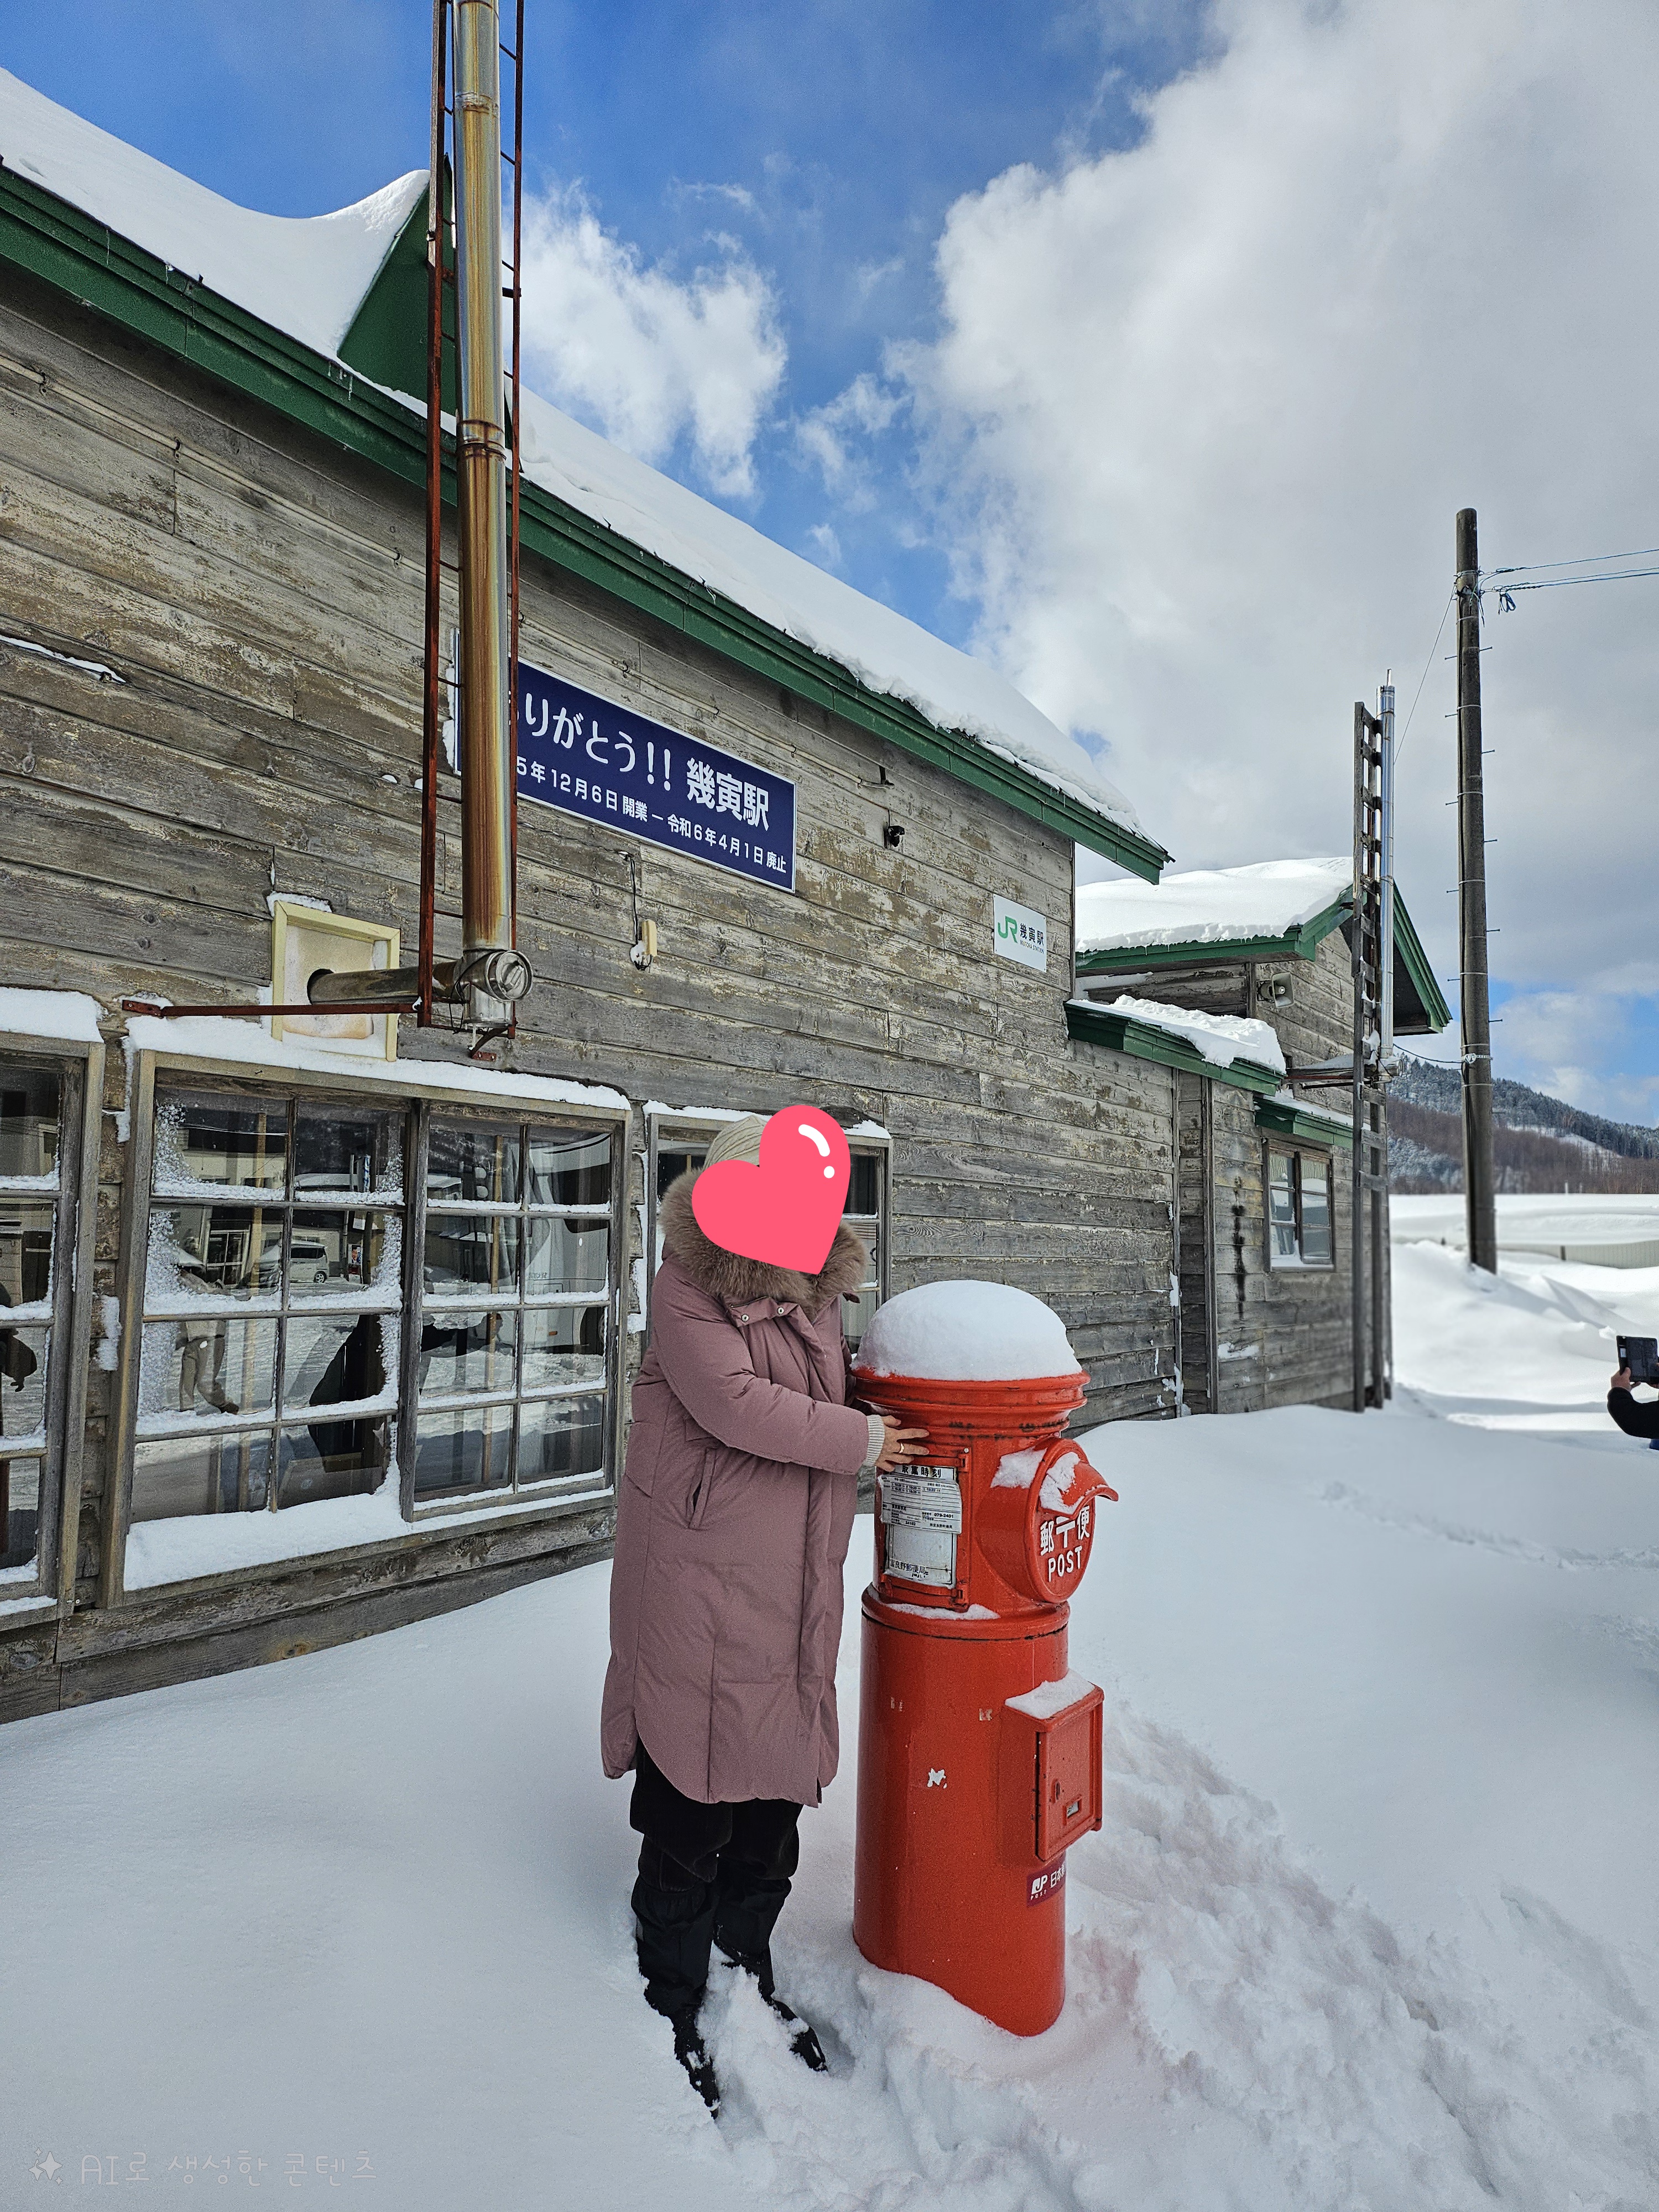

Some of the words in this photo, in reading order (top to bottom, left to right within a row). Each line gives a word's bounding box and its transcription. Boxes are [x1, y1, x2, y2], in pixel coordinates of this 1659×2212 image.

[508, 690, 671, 791] りがとう!!
[687, 757, 770, 831] 幾寅駅
[998, 916, 1018, 943] JR
[1020, 923, 1044, 946] 幾寅駅
[1048, 1546, 1082, 1582] POST
[1030, 1889, 1047, 1900] POST
